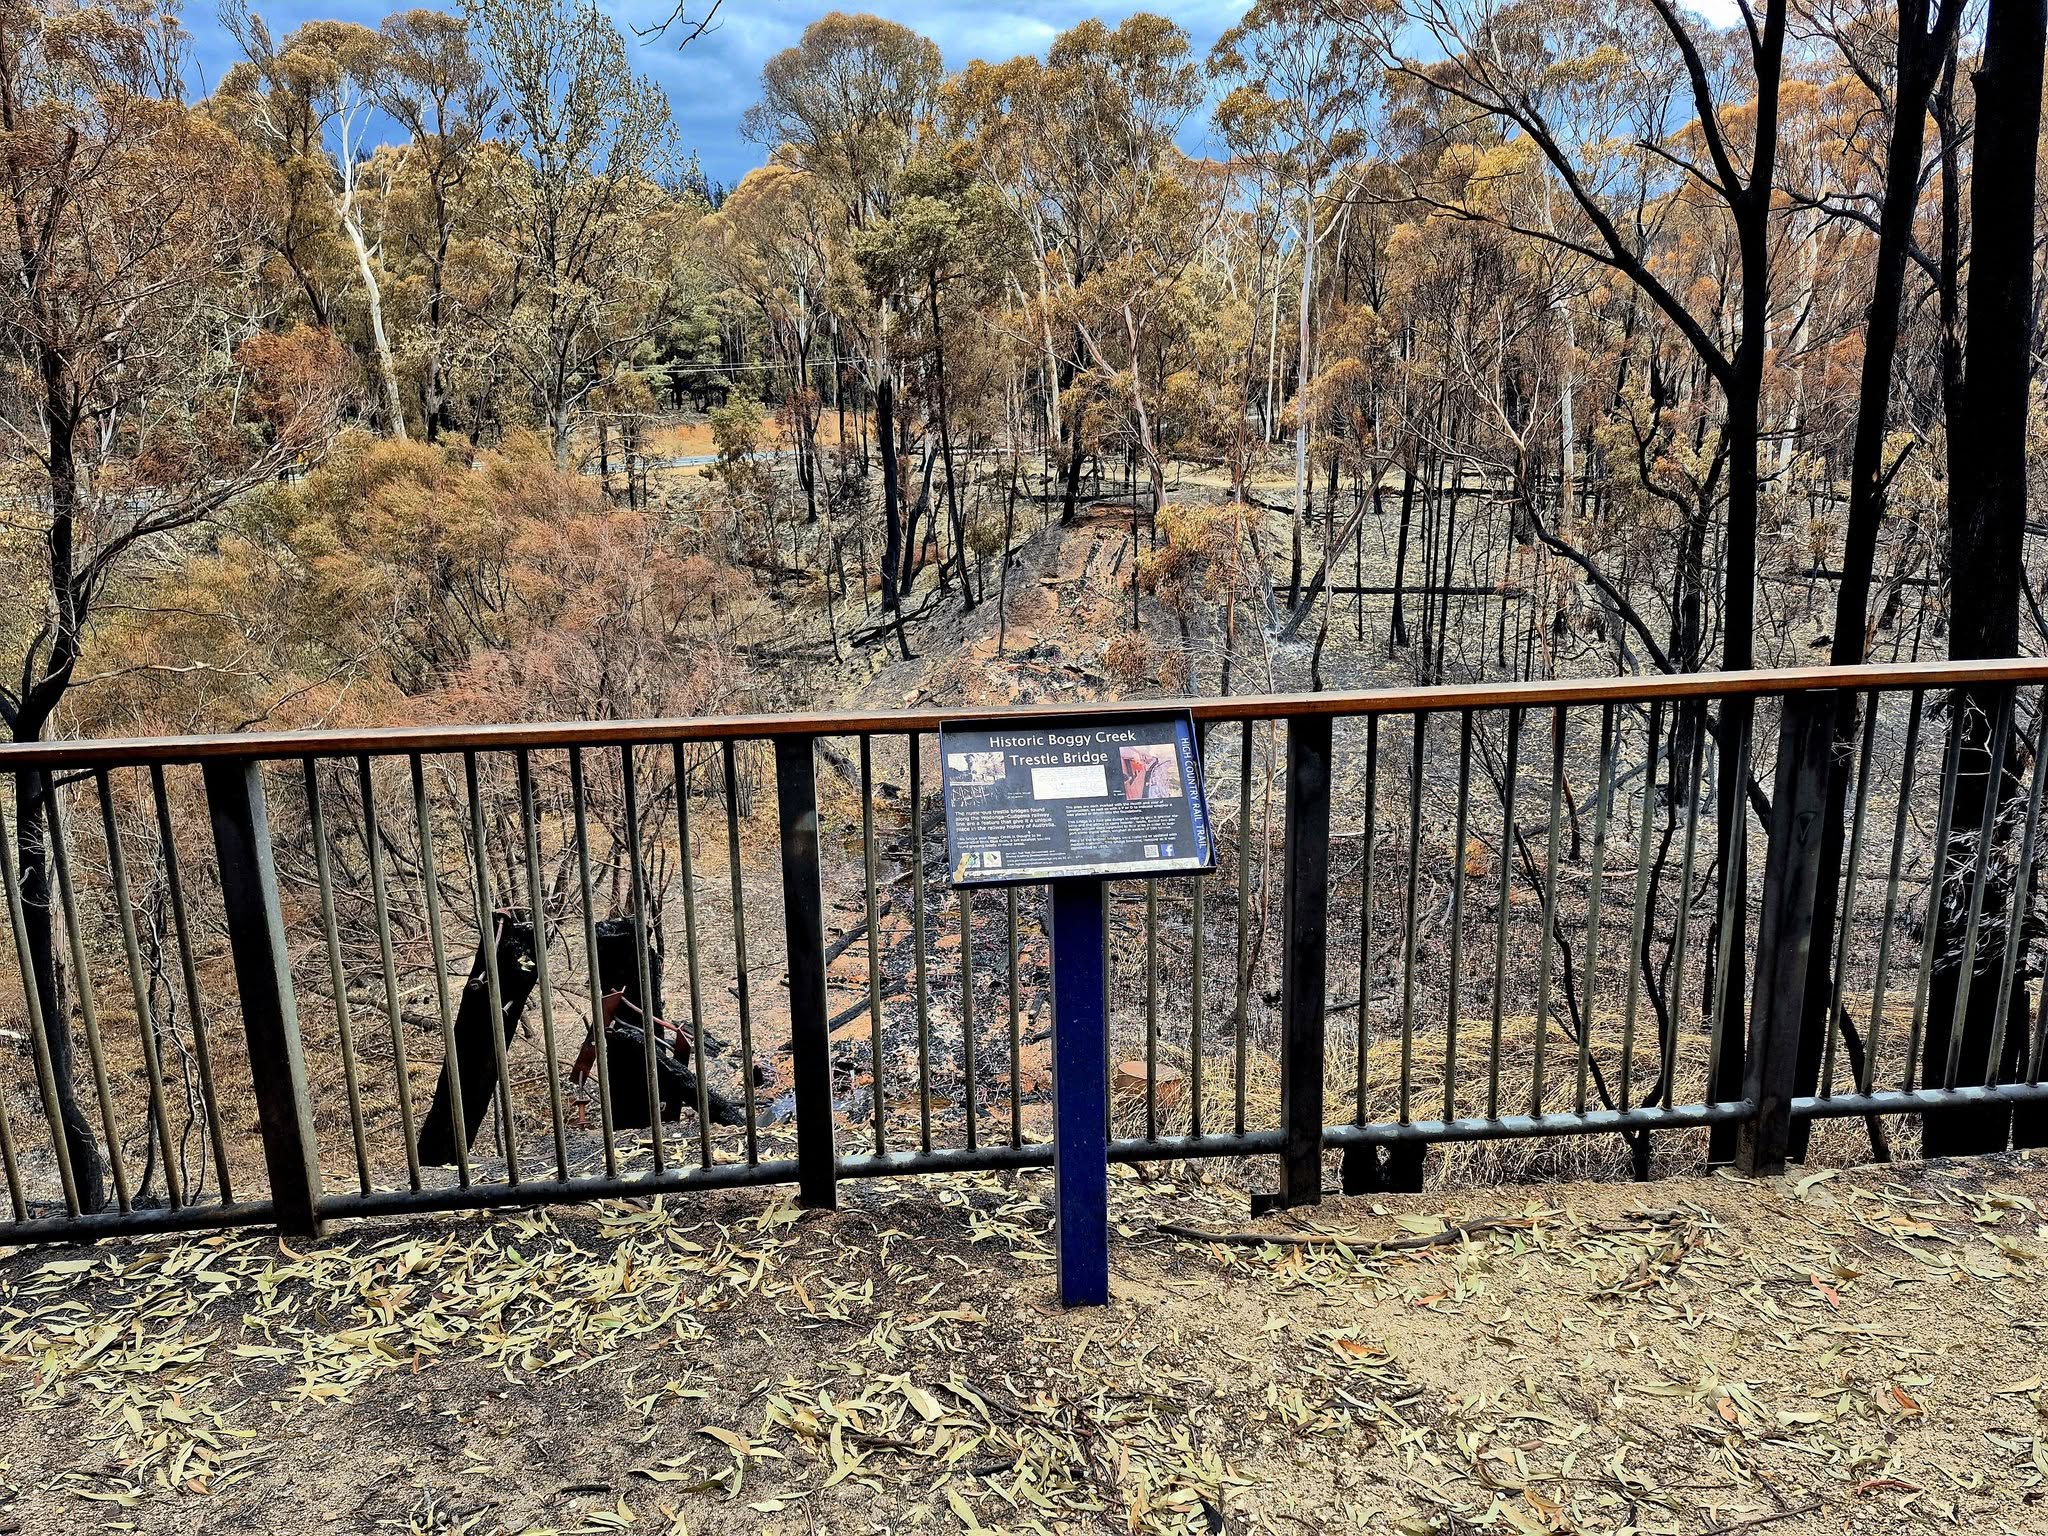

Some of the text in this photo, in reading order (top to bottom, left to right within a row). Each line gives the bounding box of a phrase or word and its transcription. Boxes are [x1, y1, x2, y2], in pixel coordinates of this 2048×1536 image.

[990, 730, 1137, 748] Historic Boggy Creek
[1009, 751, 1108, 766] Trestle Bridge
[1181, 737, 1207, 849] HIGH COUNTRY RAIL TRAIL
